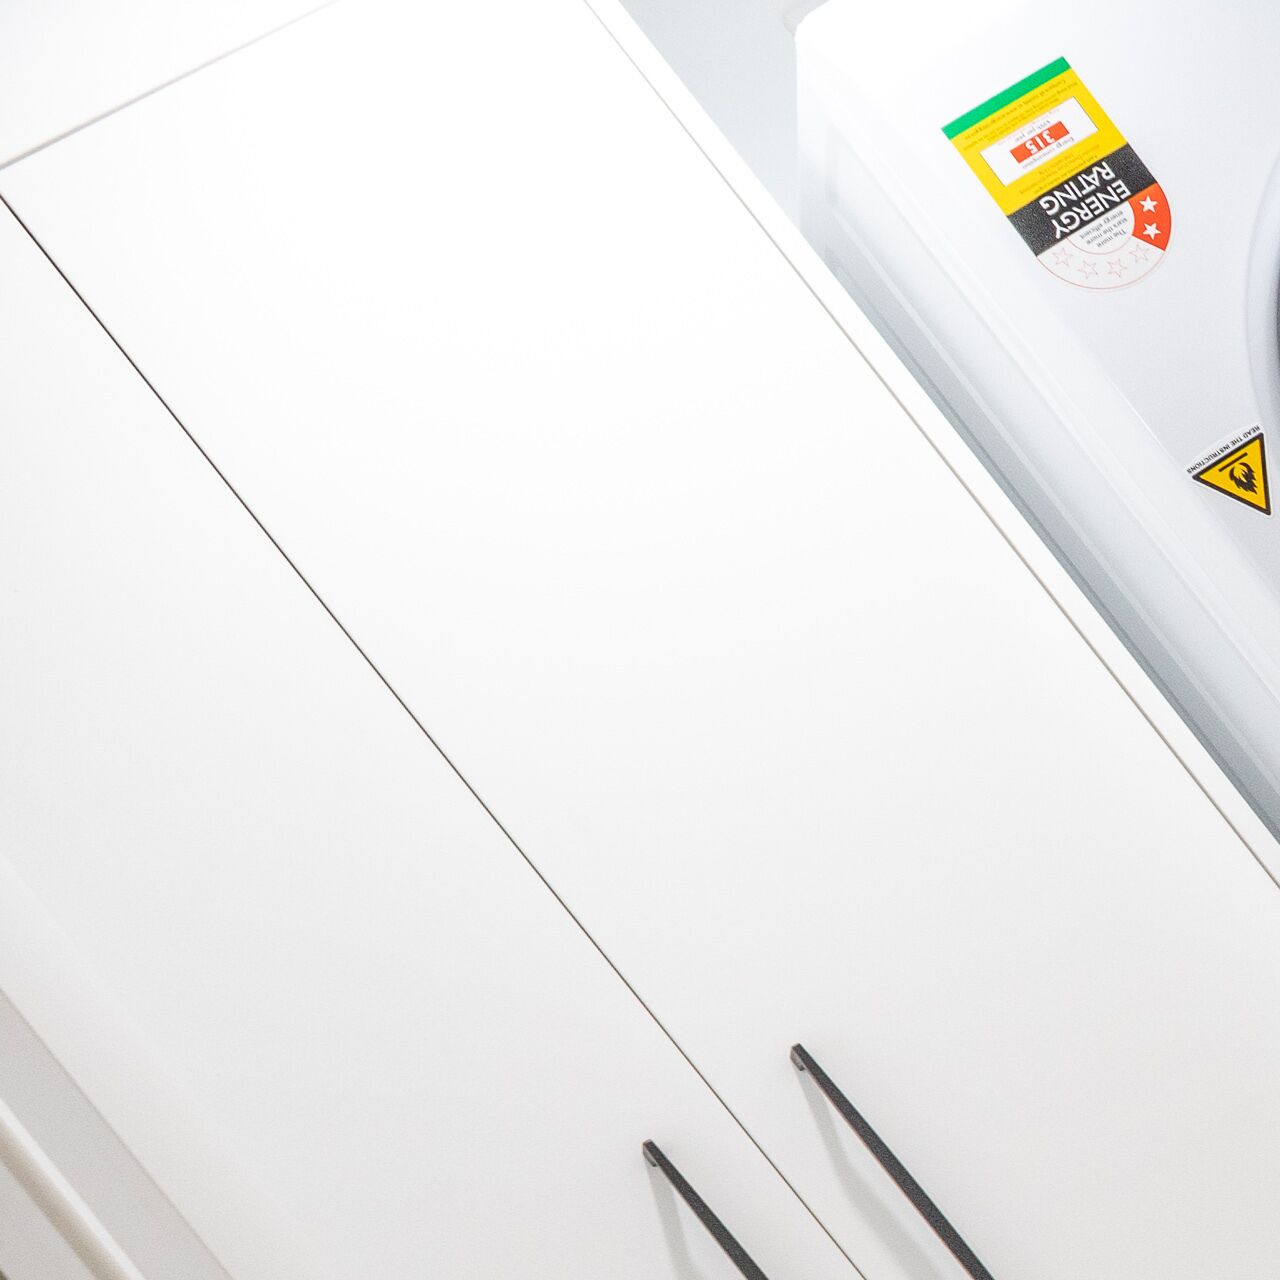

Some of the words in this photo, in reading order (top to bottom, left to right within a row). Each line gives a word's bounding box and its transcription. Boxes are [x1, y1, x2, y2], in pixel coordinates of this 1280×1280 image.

[1023, 128, 1055, 155] 315
[1037, 159, 1115, 217] RATING
[1046, 177, 1131, 239] ENERGY
[1229, 436, 1242, 447] THE
[1242, 424, 1260, 439] READ
[1185, 443, 1230, 474] INSTRUCTIONS
